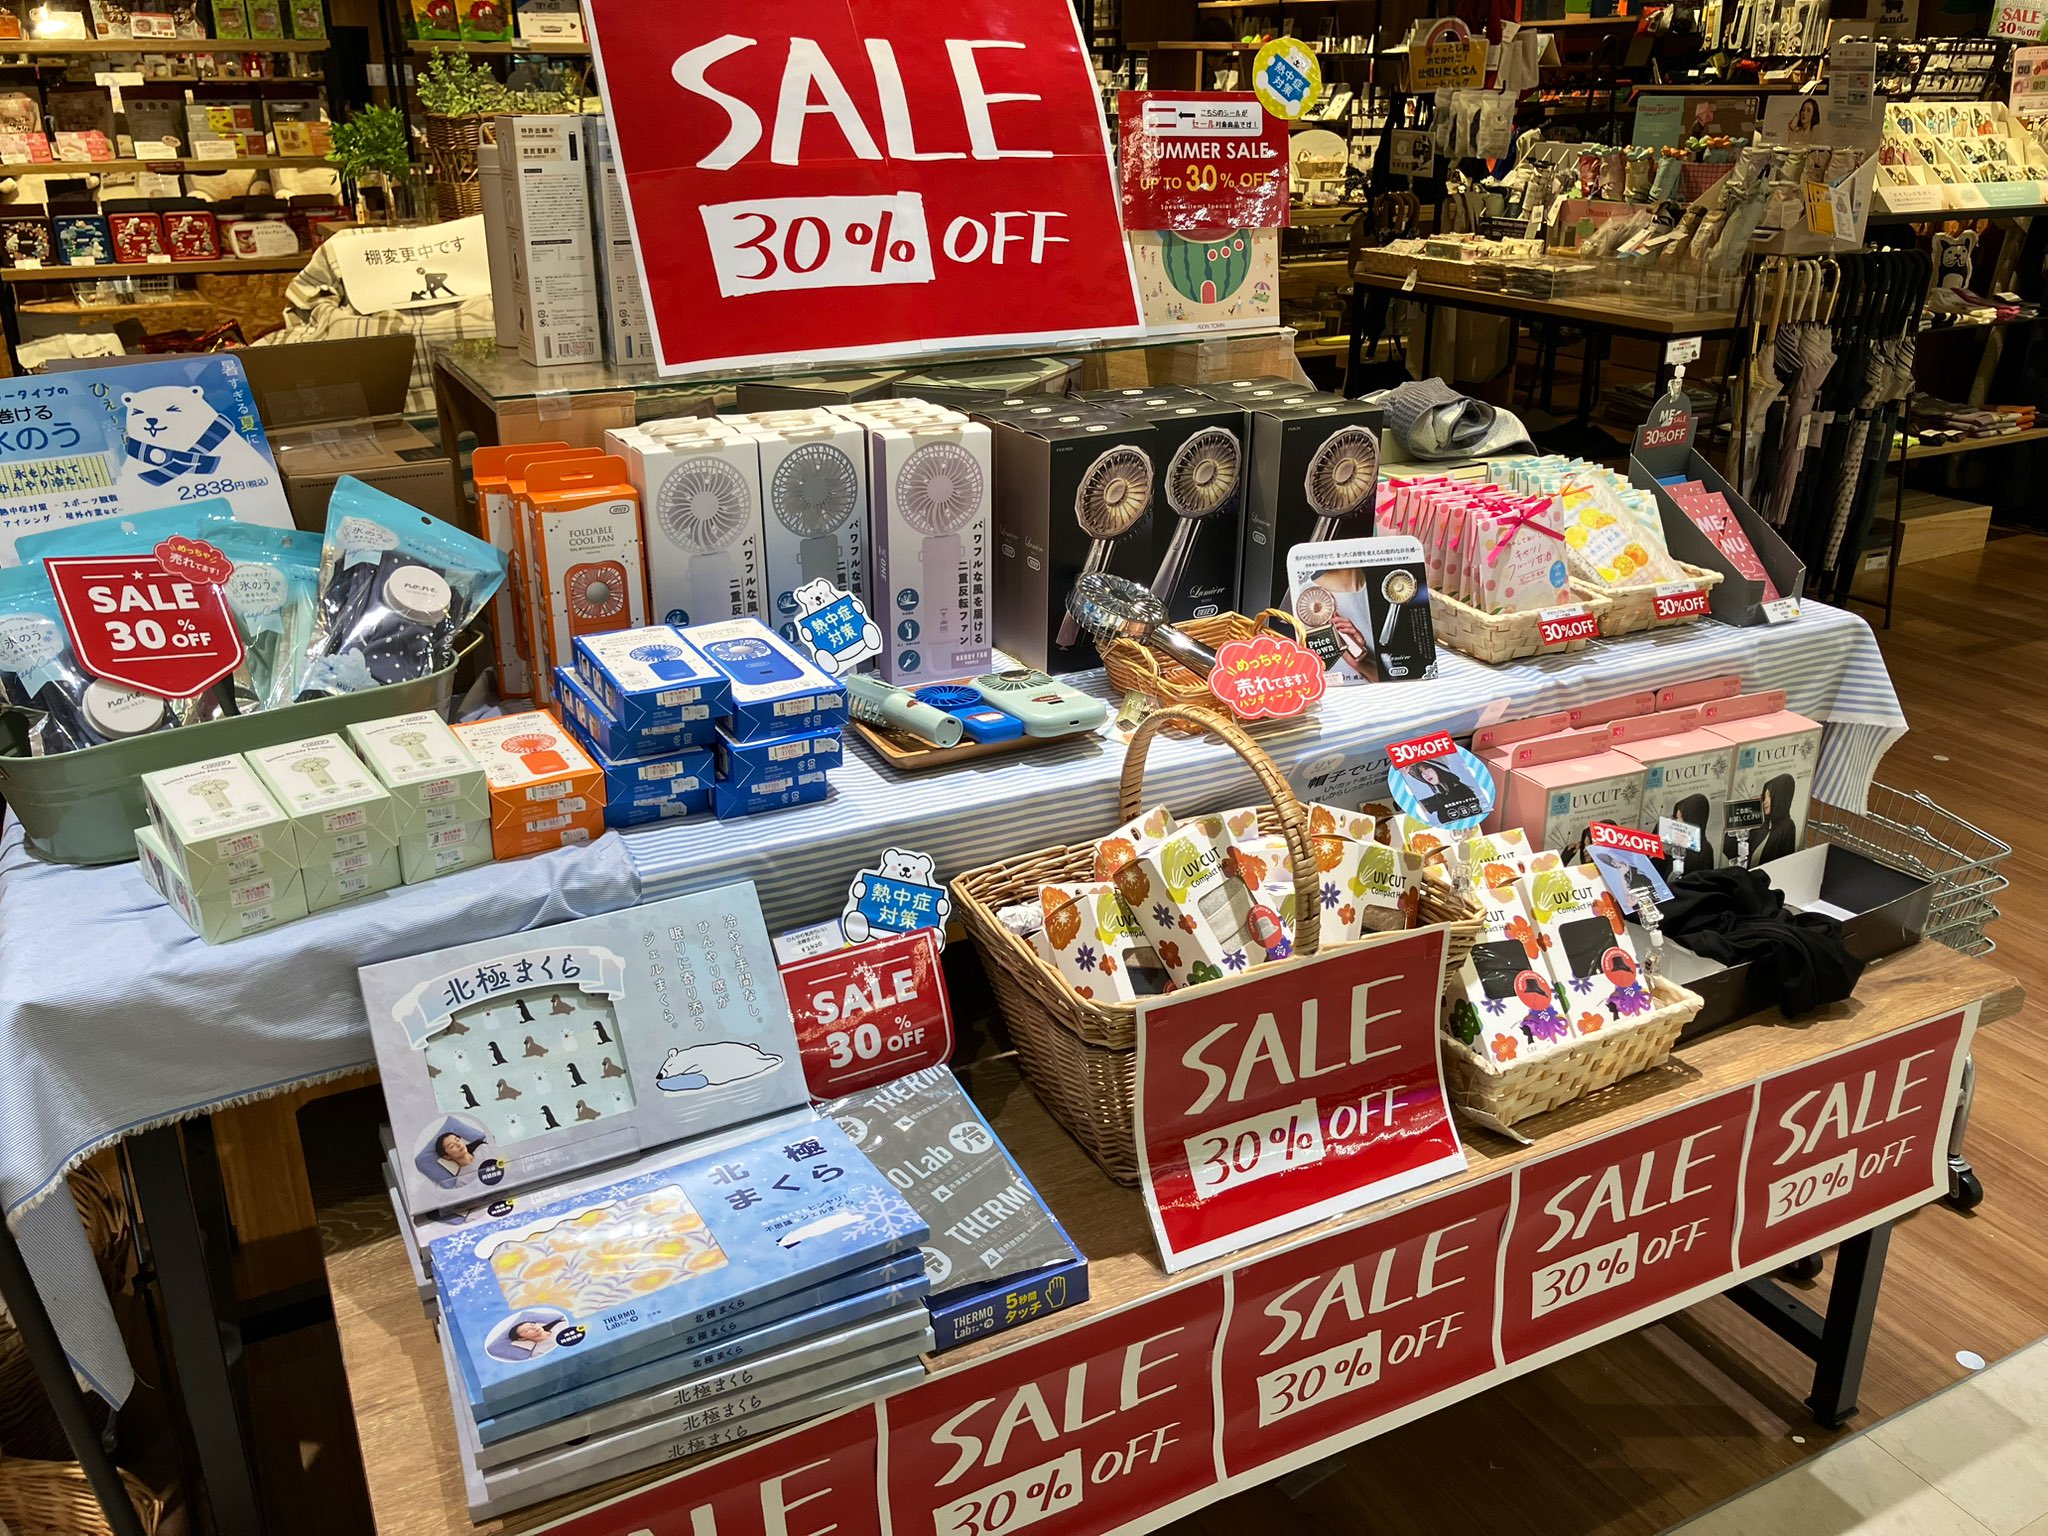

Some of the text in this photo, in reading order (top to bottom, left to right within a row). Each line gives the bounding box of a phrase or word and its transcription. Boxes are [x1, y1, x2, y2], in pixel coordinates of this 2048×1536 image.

[2001, 8, 2041, 24] SALE
[671, 34, 1053, 171] SALE
[1142, 142, 1271, 160] SUMMER SALE
[1140, 176, 1159, 191] UP
[1164, 176, 1182, 190] TO
[1240, 172, 1273, 188] OFF
[942, 210, 1070, 265] OFF
[364, 235, 466, 266] 棚変更中です
[0, 387, 68, 401] ータイプの
[221, 359, 260, 445] 暑すぎる夏に
[1644, 427, 1686, 446] 30%OFF
[15, 464, 79, 480] 氷を入れて
[569, 526, 613, 537] FOLDABLE
[569, 534, 615, 547] COOL FAN
[176, 543, 211, 561] めっちゃ
[239, 578, 271, 592] 氷のう
[973, 520, 984, 644] パワフルな風を届ける
[87, 582, 201, 614] SALE
[958, 561, 969, 646] 二重反転ファン
[1656, 596, 1705, 616] 30%OFF
[811, 604, 854, 636] 熱中症
[1541, 619, 1595, 642] 30%OFF
[4, 630, 42, 650] 氷のう
[105, 618, 167, 652] 30
[171, 632, 212, 649] OFF
[828, 623, 858, 648] 対策
[1308, 637, 1331, 649] Price
[1236, 651, 1283, 675] めっちゃ
[1238, 685, 1312, 708] ハンディーファン
[1391, 737, 1451, 763] 30%OFF
[1596, 824, 1660, 853] 30%OFF
[1183, 846, 1222, 878] UV CUT
[1191, 865, 1218, 888] Compact
[1373, 871, 1407, 889] UV CUT
[871, 882, 933, 913] 熱中症
[1370, 886, 1395, 899] Compact
[1553, 887, 1594, 905] UV CUT
[880, 905, 920, 930] 対策
[1115, 914, 1132, 928] UV
[1557, 903, 1582, 915] Compact
[1120, 929, 1146, 939] Compac
[697, 920, 730, 1010] ひんやり感が
[442, 954, 581, 1006] 北極まくら
[668, 925, 706, 1032] 眠りに寄り添う
[812, 968, 918, 1025] SALE
[826, 1023, 882, 1069] 30
[887, 1028, 925, 1052] OFF
[1182, 974, 1405, 1116] SALE
[1329, 1085, 1409, 1141] OFF
[1773, 1049, 1935, 1166] SALE
[1858, 1136, 1914, 1180] OFF
[724, 1163, 845, 1211] まくら
[1536, 1124, 1724, 1254] SALE
[1642, 1220, 1709, 1266] OFF
[1259, 1217, 1479, 1358] SALE
[694, 1299, 745, 1324] 北極まくら
[1005, 1291, 1037, 1310] 5秒間
[1005, 1301, 1043, 1324] タッチ
[602, 1309, 637, 1325] THERMO
[605, 1321, 621, 1332] Lab
[953, 1305, 994, 1329] THERMO
[685, 1322, 737, 1345] 北極まくら
[954, 1326, 972, 1340] Lab
[1387, 1311, 1465, 1366] OFF
[692, 1345, 743, 1368] 北極まくら
[673, 1369, 754, 1406] 北極まくら
[683, 1395, 762, 1432] 北極まくら
[931, 1326, 1185, 1488] SALE
[667, 1425, 748, 1459] 北極まくら
[1090, 1421, 1181, 1485] OFF
